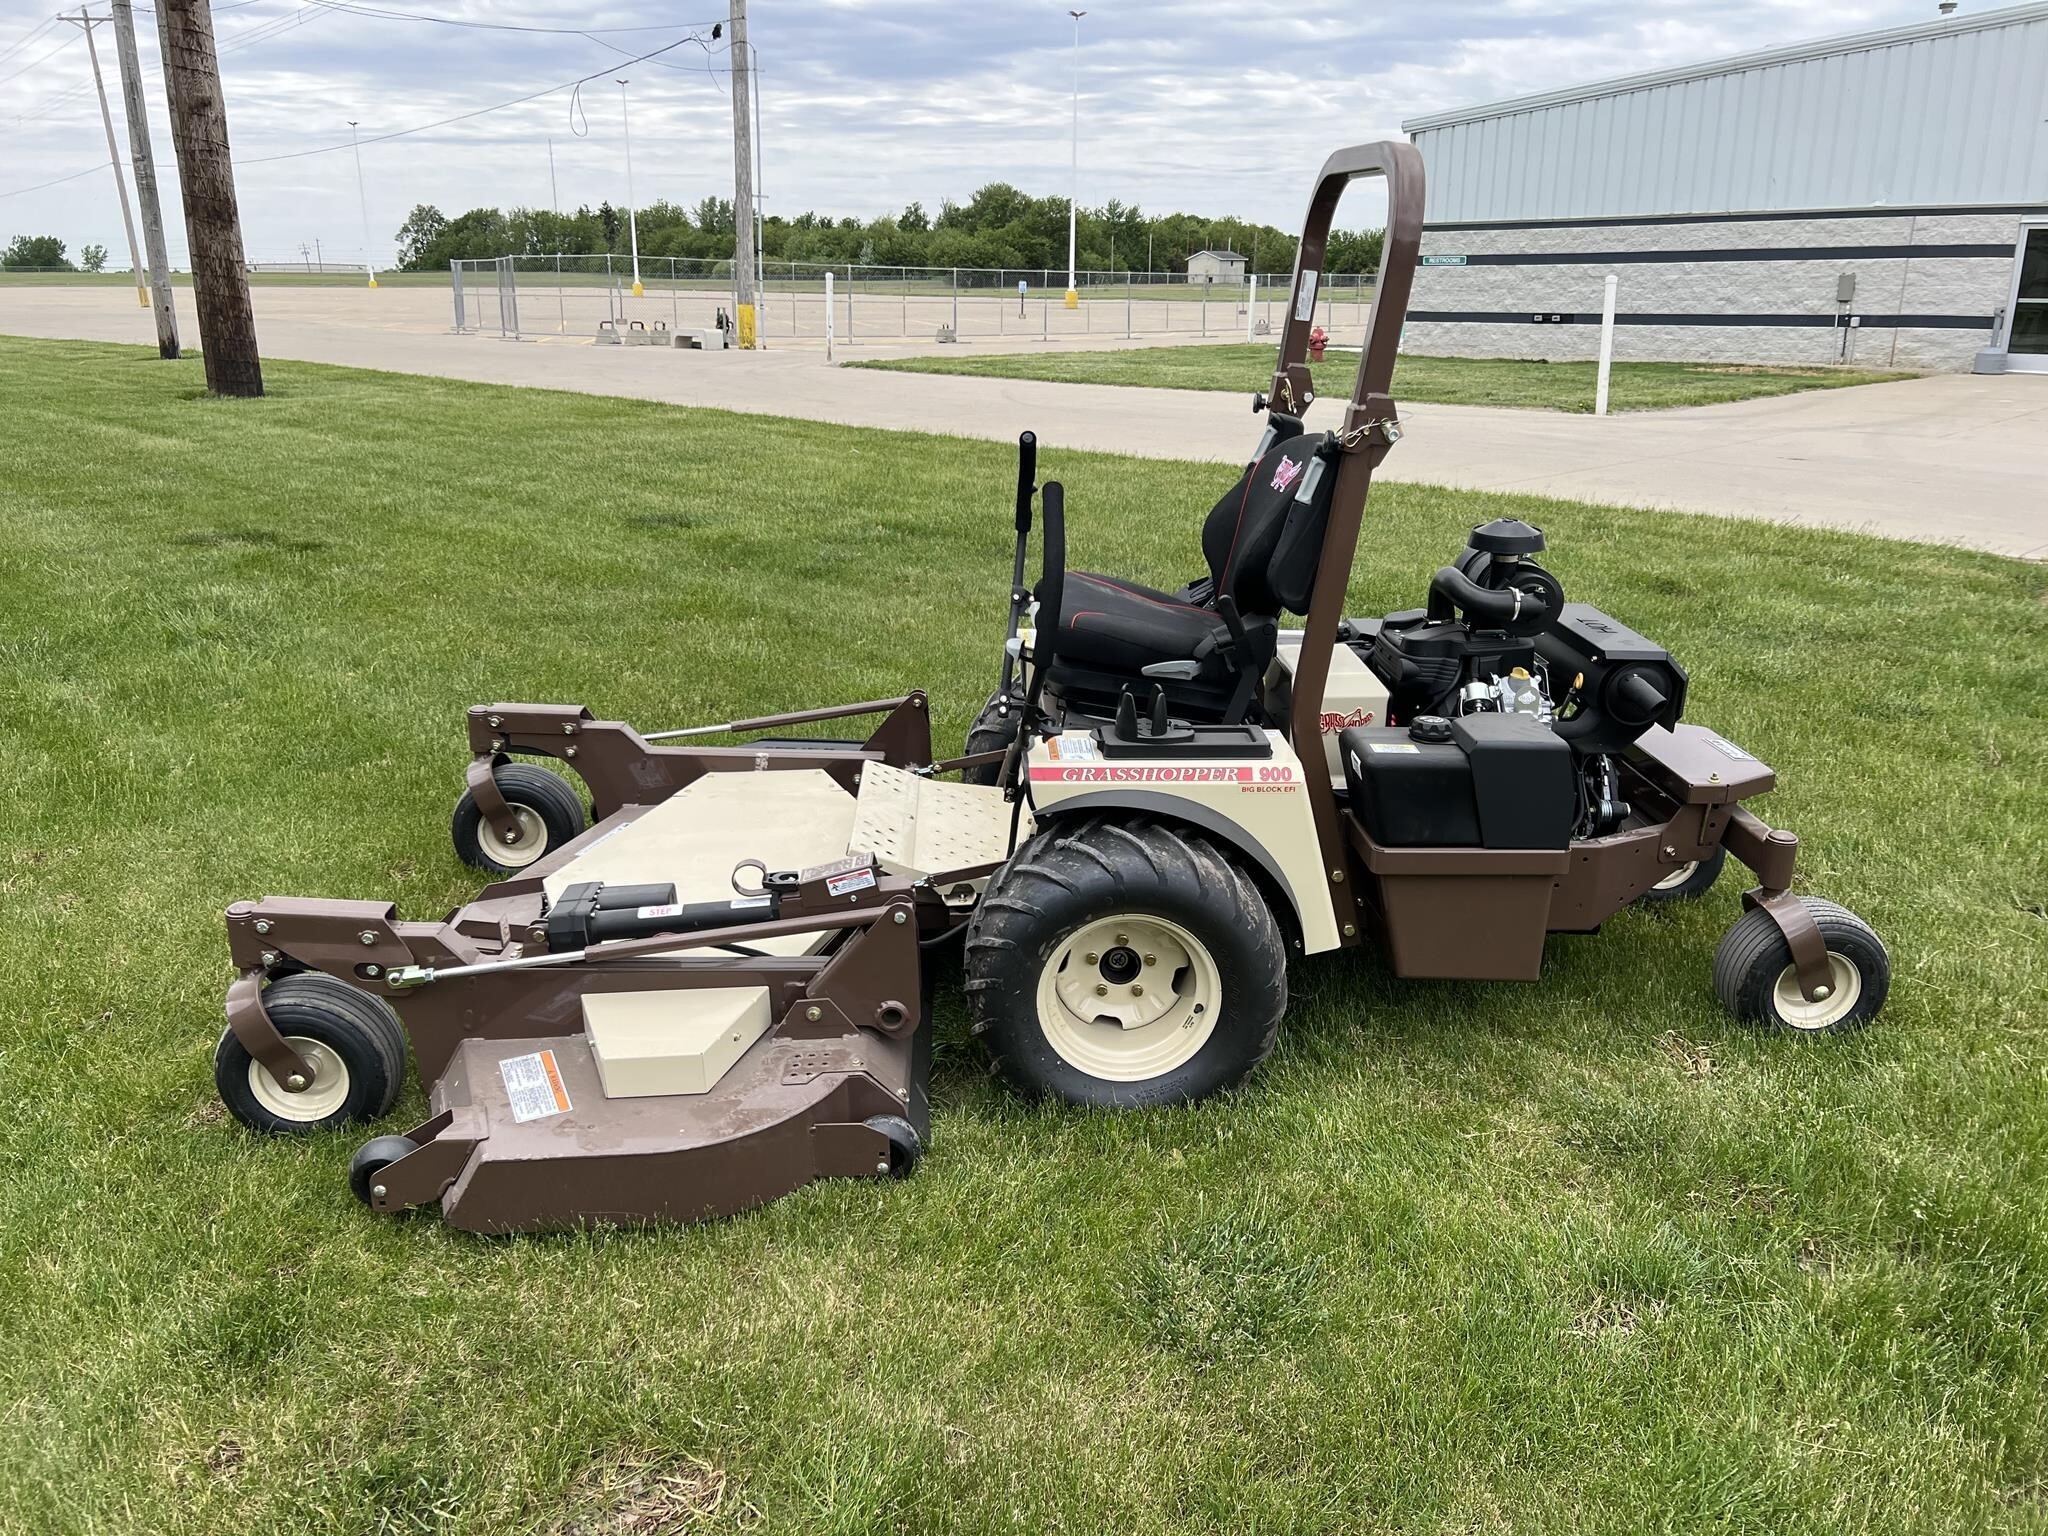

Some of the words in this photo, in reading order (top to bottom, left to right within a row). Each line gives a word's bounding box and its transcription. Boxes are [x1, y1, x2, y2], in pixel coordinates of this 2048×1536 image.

[1062, 767, 1239, 782] GRASSHOPPER
[1259, 767, 1292, 781] 900
[649, 907, 672, 916] STEP
